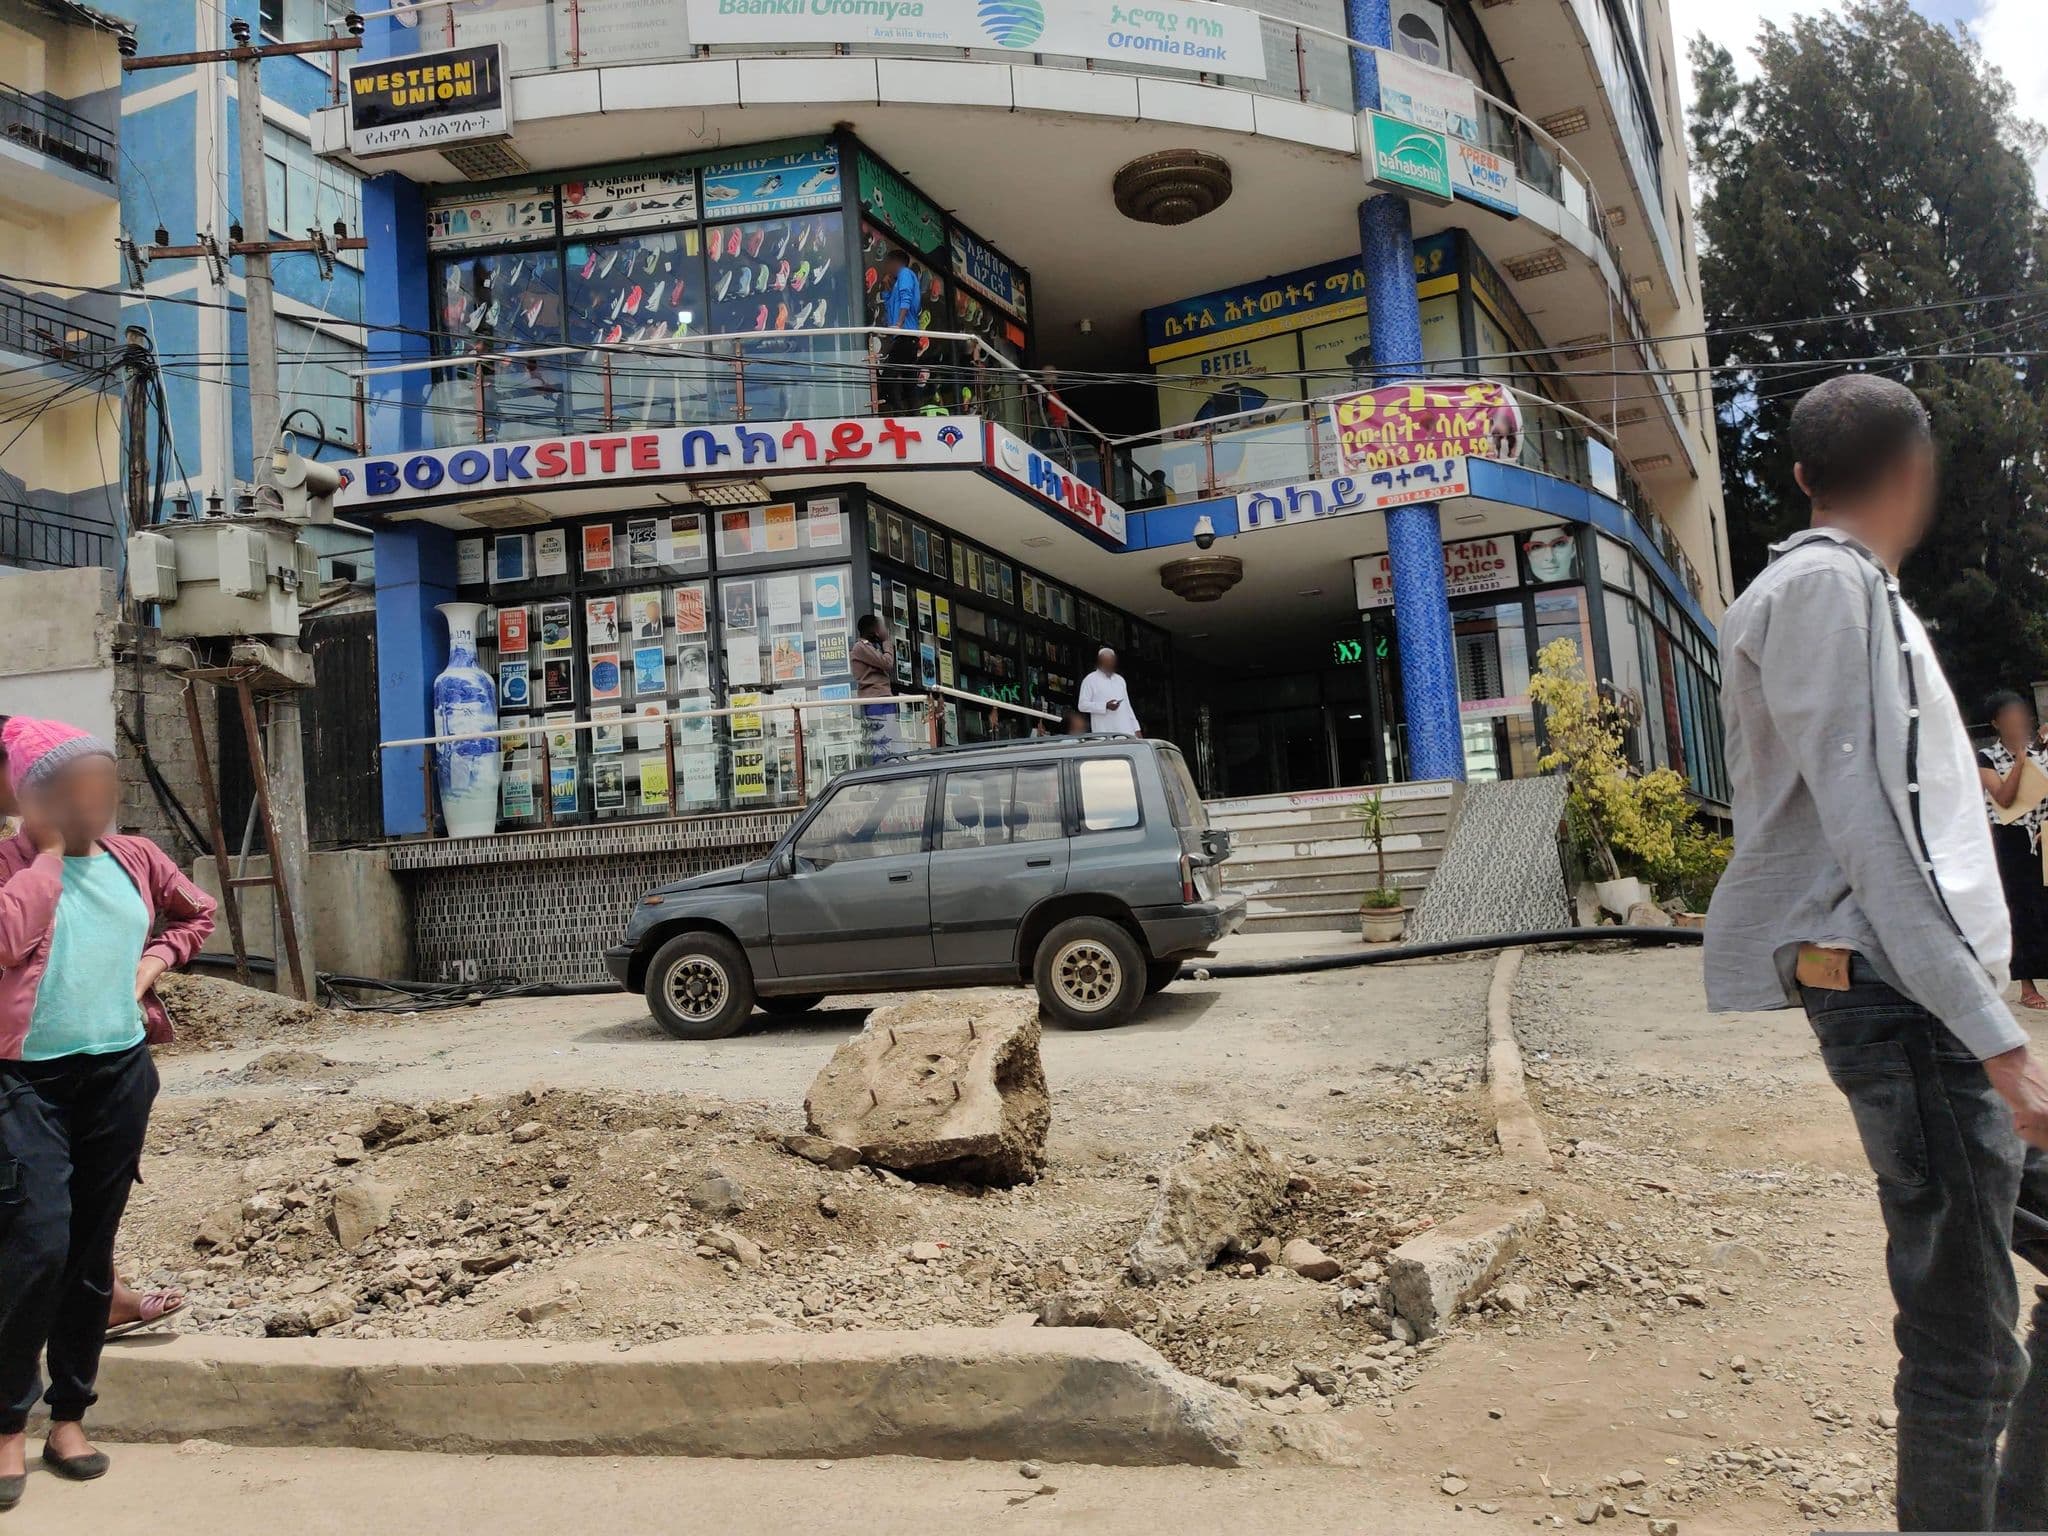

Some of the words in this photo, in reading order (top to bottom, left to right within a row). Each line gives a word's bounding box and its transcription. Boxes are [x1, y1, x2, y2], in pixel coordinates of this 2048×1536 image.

[1108, 32, 1179, 53] Oromia
[1183, 40, 1227, 60] Bank
[354, 61, 472, 95] WESTERN
[392, 80, 472, 106] UNION
[1379, 151, 1441, 183] Dahabshiil
[1458, 144, 1500, 171] XPRESS
[1472, 164, 1508, 188] MONEY
[606, 183, 645, 198] Sport
[1201, 349, 1252, 375] BETEL
[1415, 442, 1437, 461] 26
[1387, 491, 1411, 504] 0911
[1429, 488, 1442, 499] 20
[820, 636, 844, 648] HIGH
[820, 650, 846, 660] HABITS
[735, 754, 763, 767] DEEP
[552, 779, 574, 796] NOW
[735, 773, 764, 785] WORK
